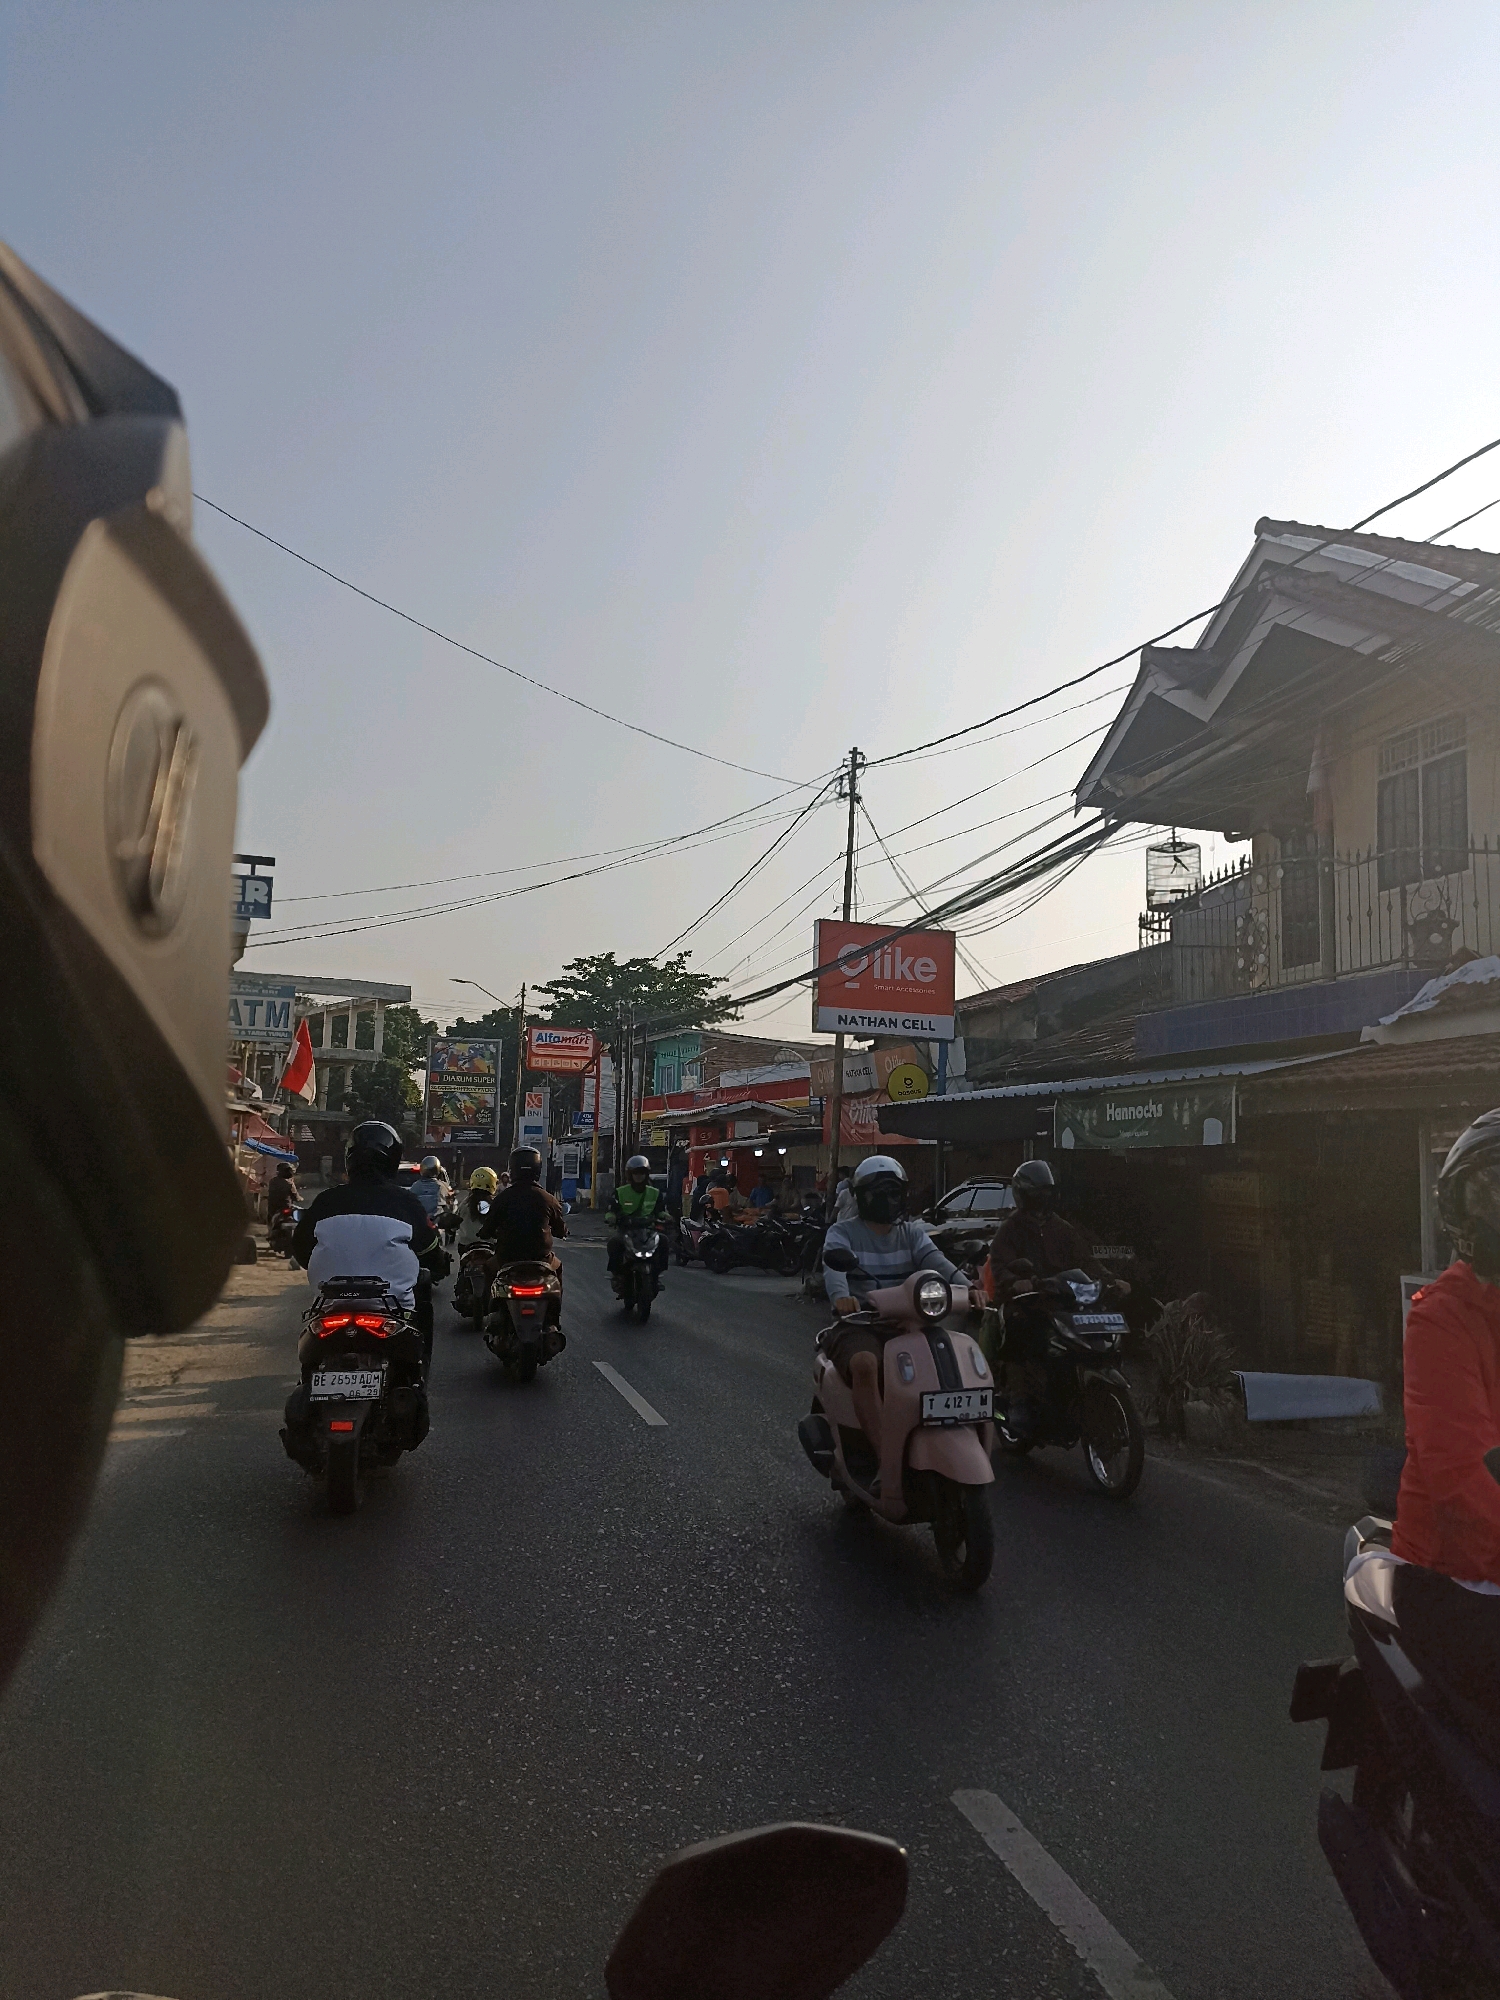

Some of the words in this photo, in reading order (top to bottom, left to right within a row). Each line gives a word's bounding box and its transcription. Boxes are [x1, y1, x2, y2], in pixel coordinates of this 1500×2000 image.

[896, 986, 937, 995] Accessories
[228, 998, 291, 1029] ATM
[837, 1014, 898, 1029] NATHAN
[901, 1018, 936, 1032] CELL
[535, 1032, 590, 1045] Alfamart
[473, 1076, 496, 1084] SUPER
[1106, 1099, 1163, 1121] Hannochs
[313, 1374, 327, 1387] BE
[929, 1398, 935, 1410] T
[944, 1395, 972, 1410] 4127
